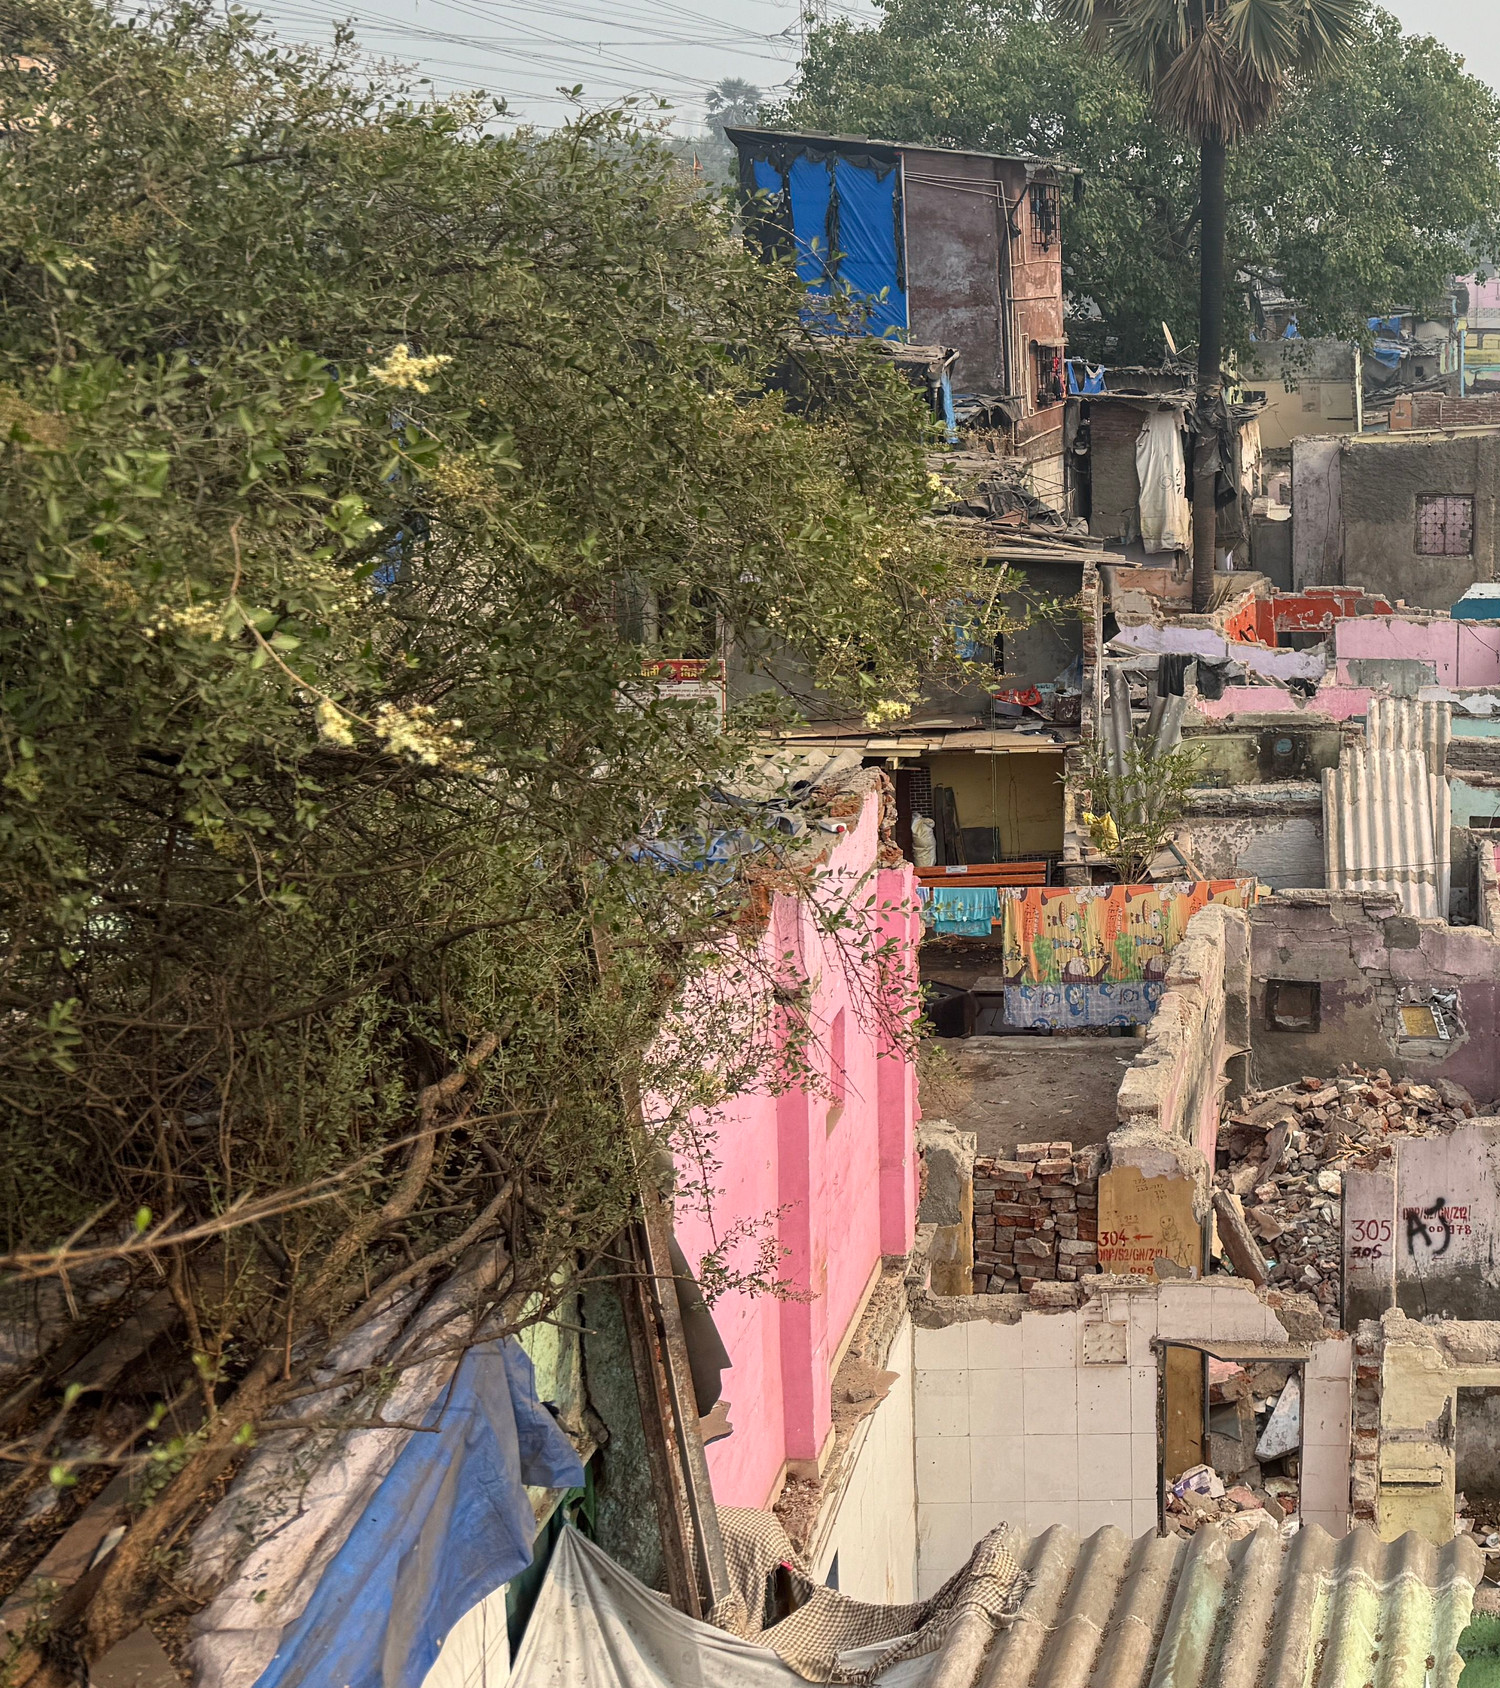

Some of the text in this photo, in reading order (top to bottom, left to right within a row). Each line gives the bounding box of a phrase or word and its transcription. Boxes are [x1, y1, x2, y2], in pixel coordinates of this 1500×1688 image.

[1098, 1228, 1129, 1247] 304
[1351, 1219, 1391, 1242] 305
[1350, 1243, 1383, 1259] 305
